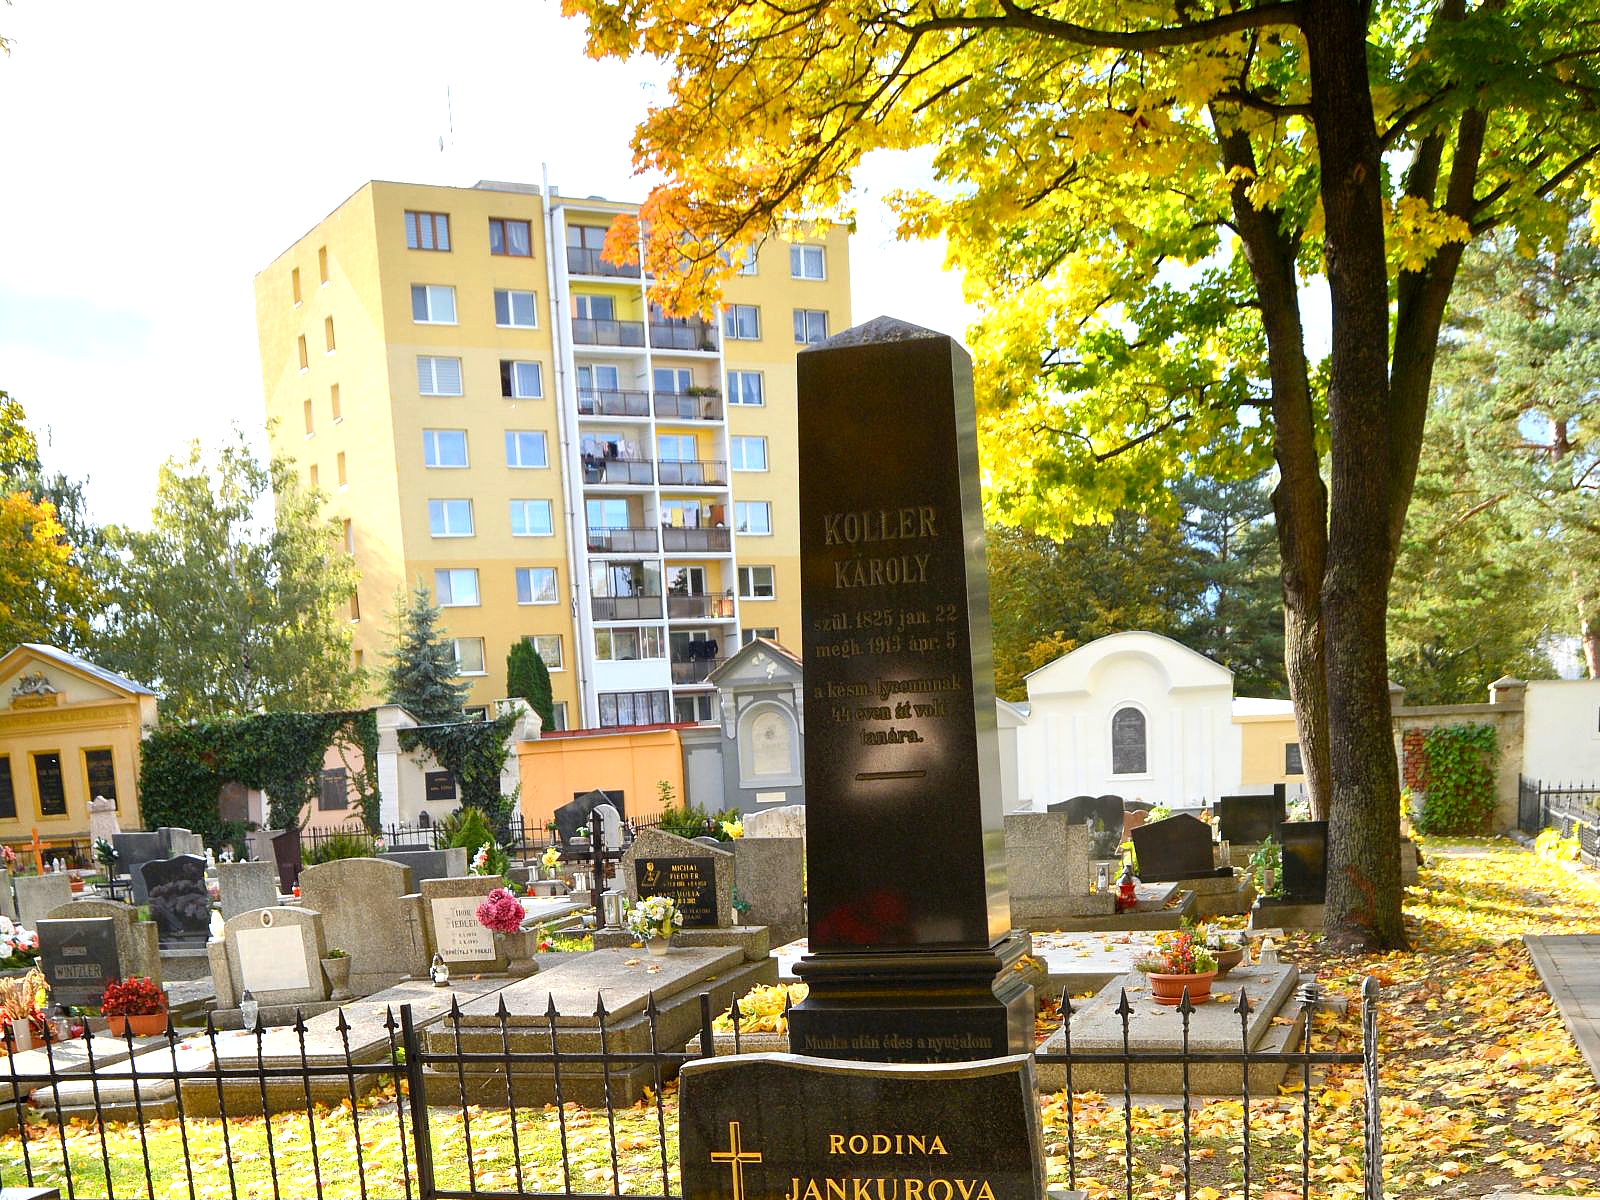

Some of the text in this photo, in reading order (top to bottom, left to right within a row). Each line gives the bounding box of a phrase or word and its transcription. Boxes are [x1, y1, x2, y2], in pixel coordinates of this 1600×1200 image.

[824, 506, 939, 546] KOLLER
[834, 551, 931, 589] KÁROLY
[855, 608, 894, 628] 1825
[935, 603, 958, 623] 22
[946, 630, 957, 650] 5
[828, 1133, 949, 1156] RODINA
